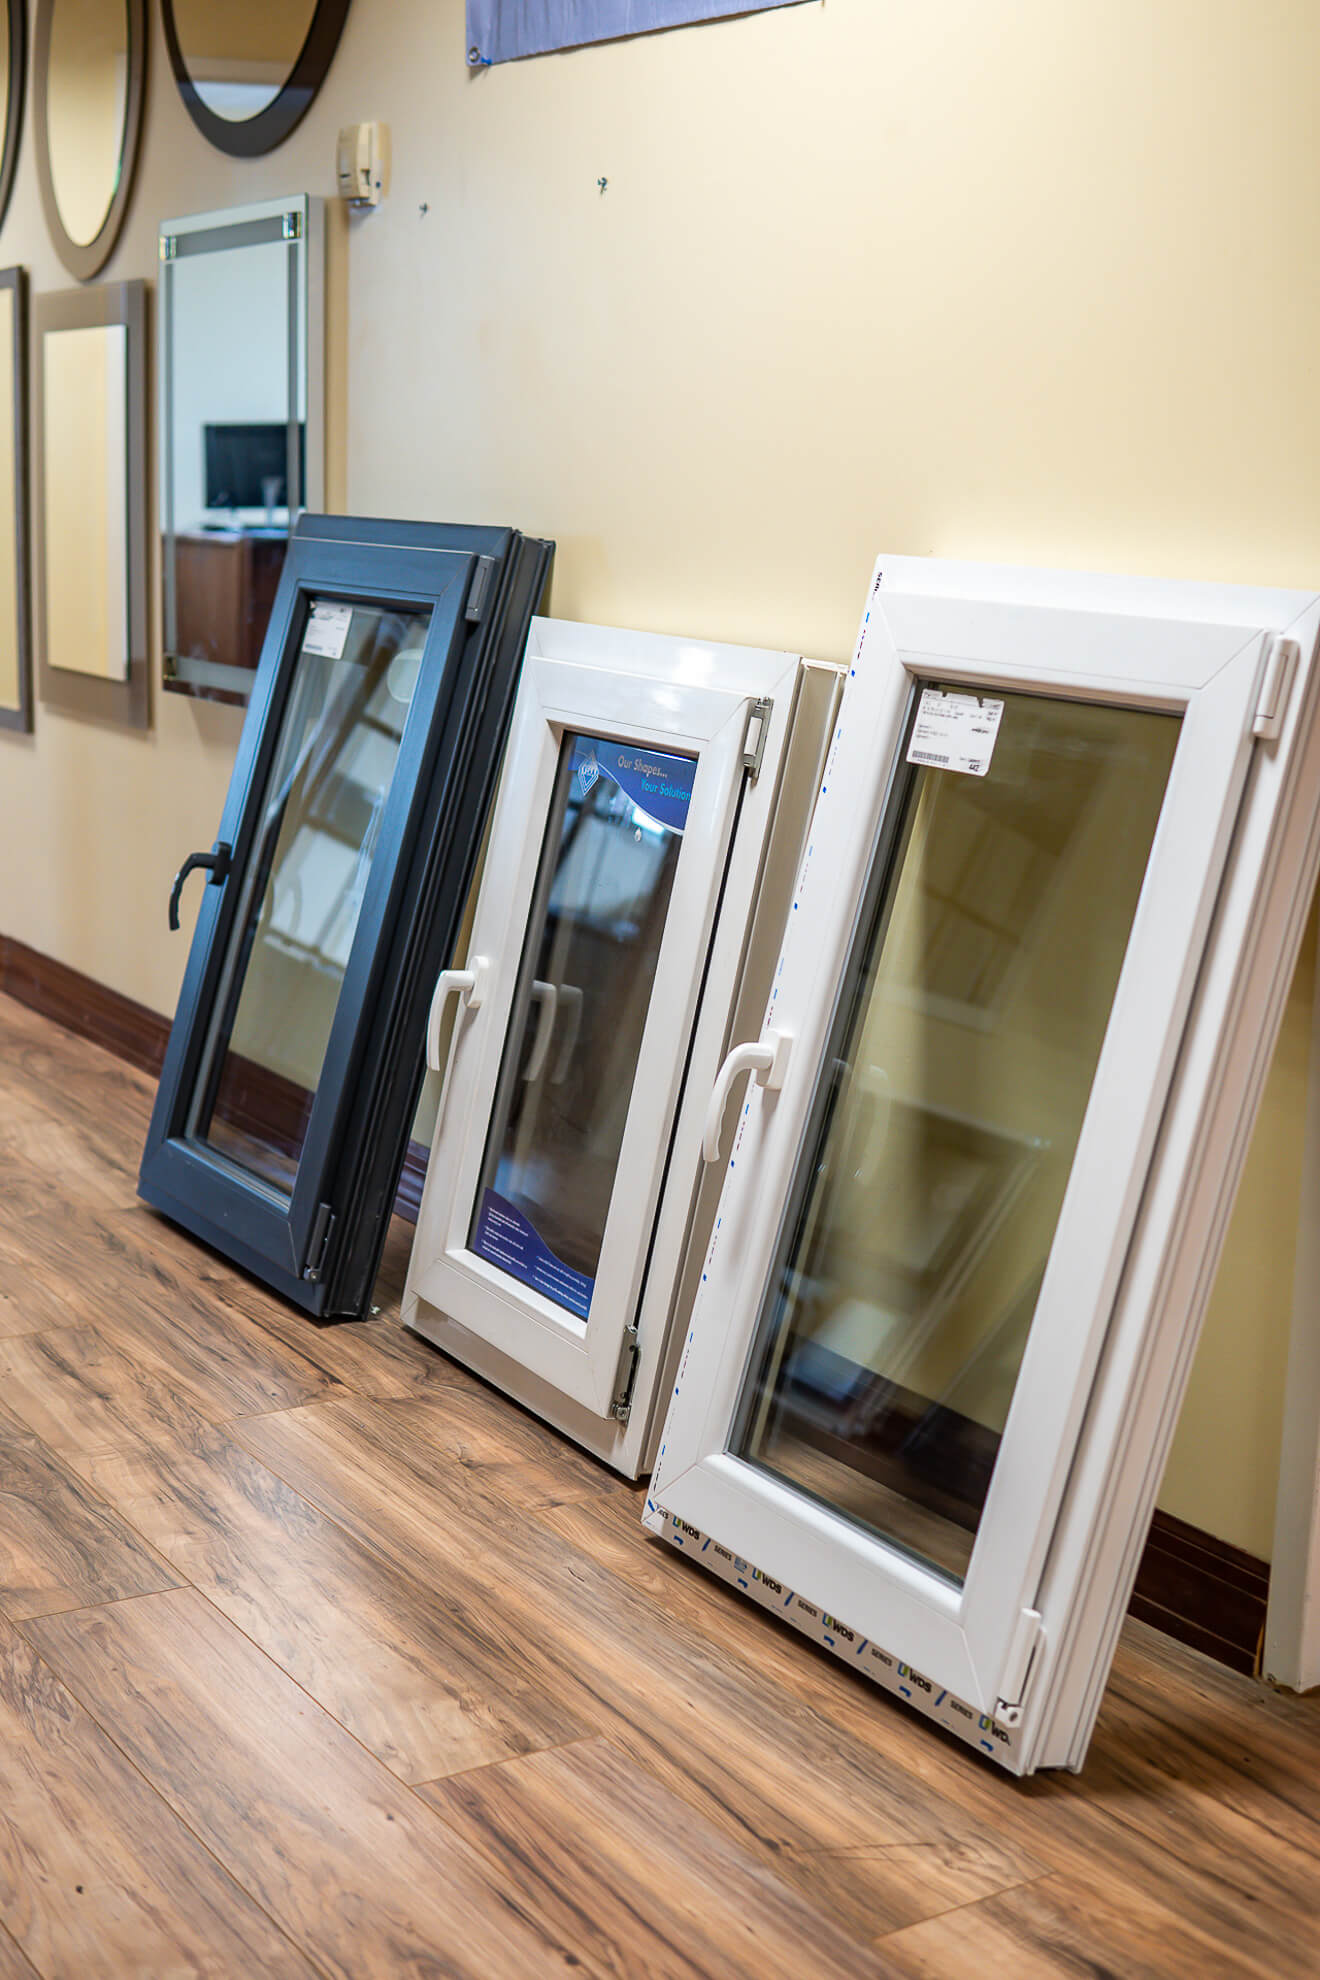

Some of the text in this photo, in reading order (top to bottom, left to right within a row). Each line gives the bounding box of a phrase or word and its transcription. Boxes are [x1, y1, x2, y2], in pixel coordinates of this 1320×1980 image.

[617, 754, 632, 769] Our
[640, 778, 658, 793] Your
[681, 1520, 700, 1540] WDS
[762, 1572, 782, 1594] WDS
[832, 1618, 854, 1642] WDS
[909, 1667, 932, 1693] WDS
[991, 1720, 1011, 1746] WD
